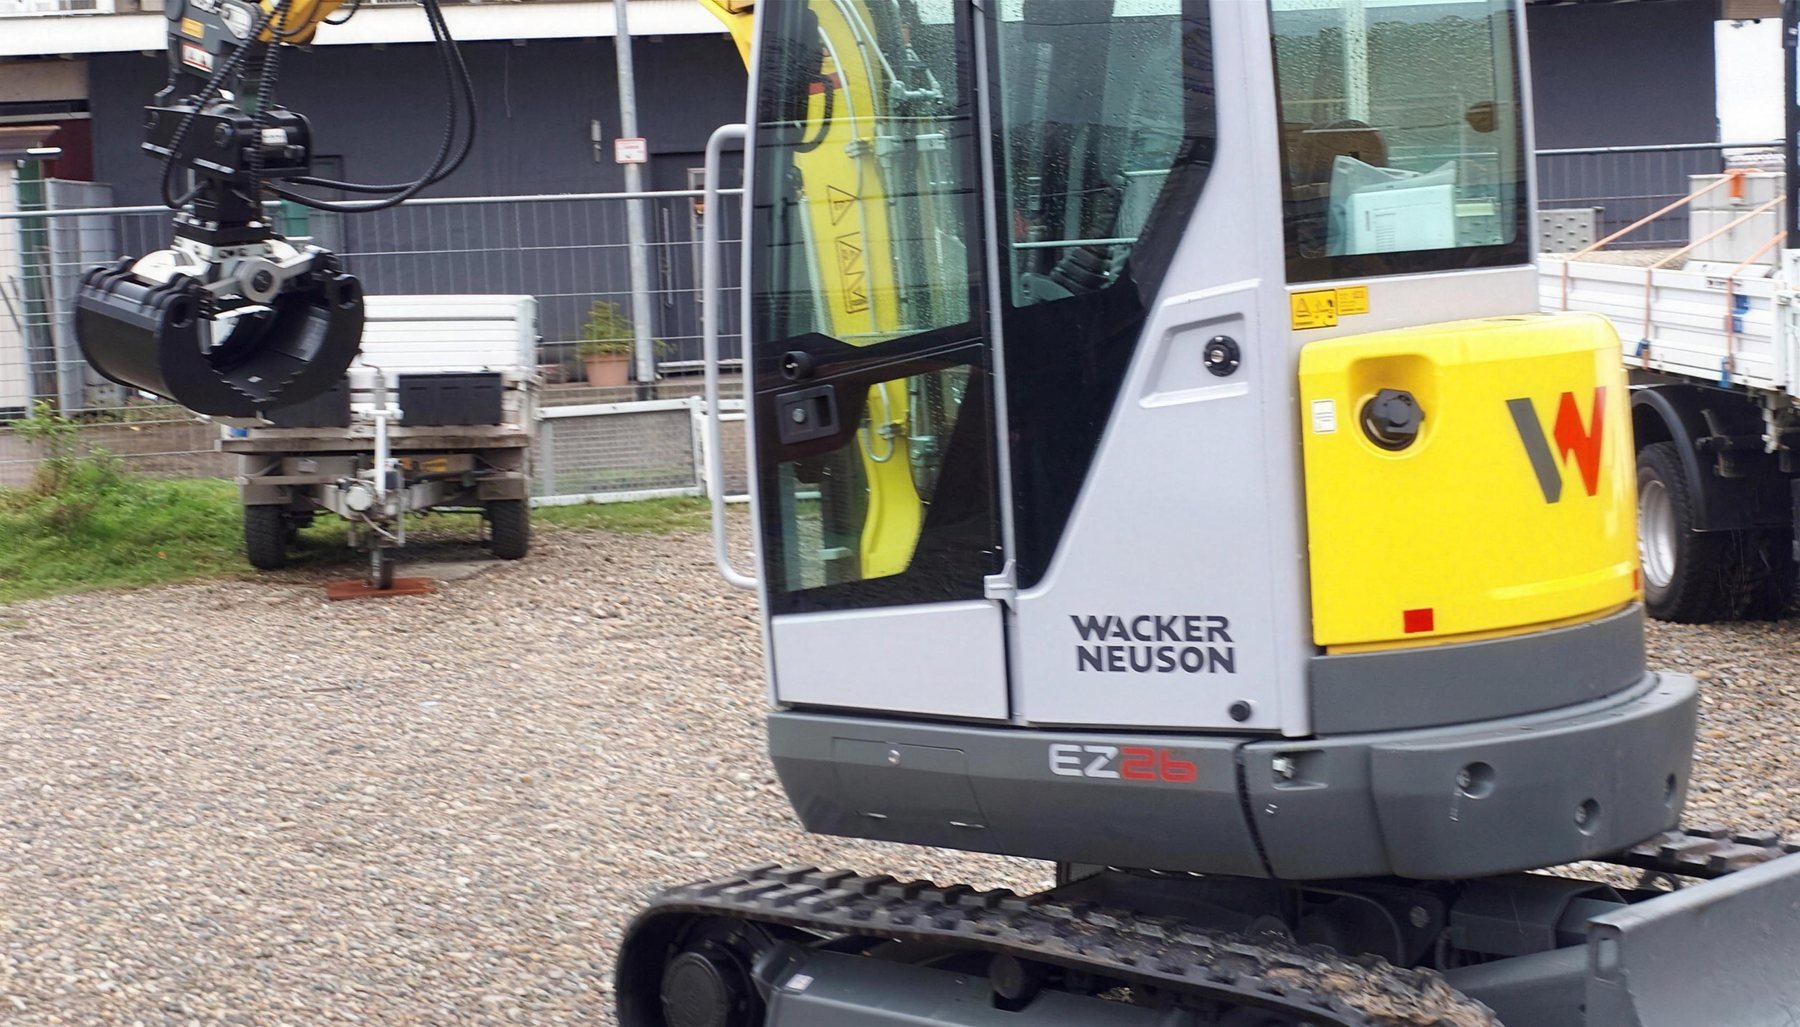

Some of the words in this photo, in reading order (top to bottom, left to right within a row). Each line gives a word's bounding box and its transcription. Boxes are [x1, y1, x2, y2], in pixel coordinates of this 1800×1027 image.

[1069, 615, 1234, 642] WACKER
[1076, 645, 1237, 673] NEUSON
[1049, 743, 1198, 783] EZ26
